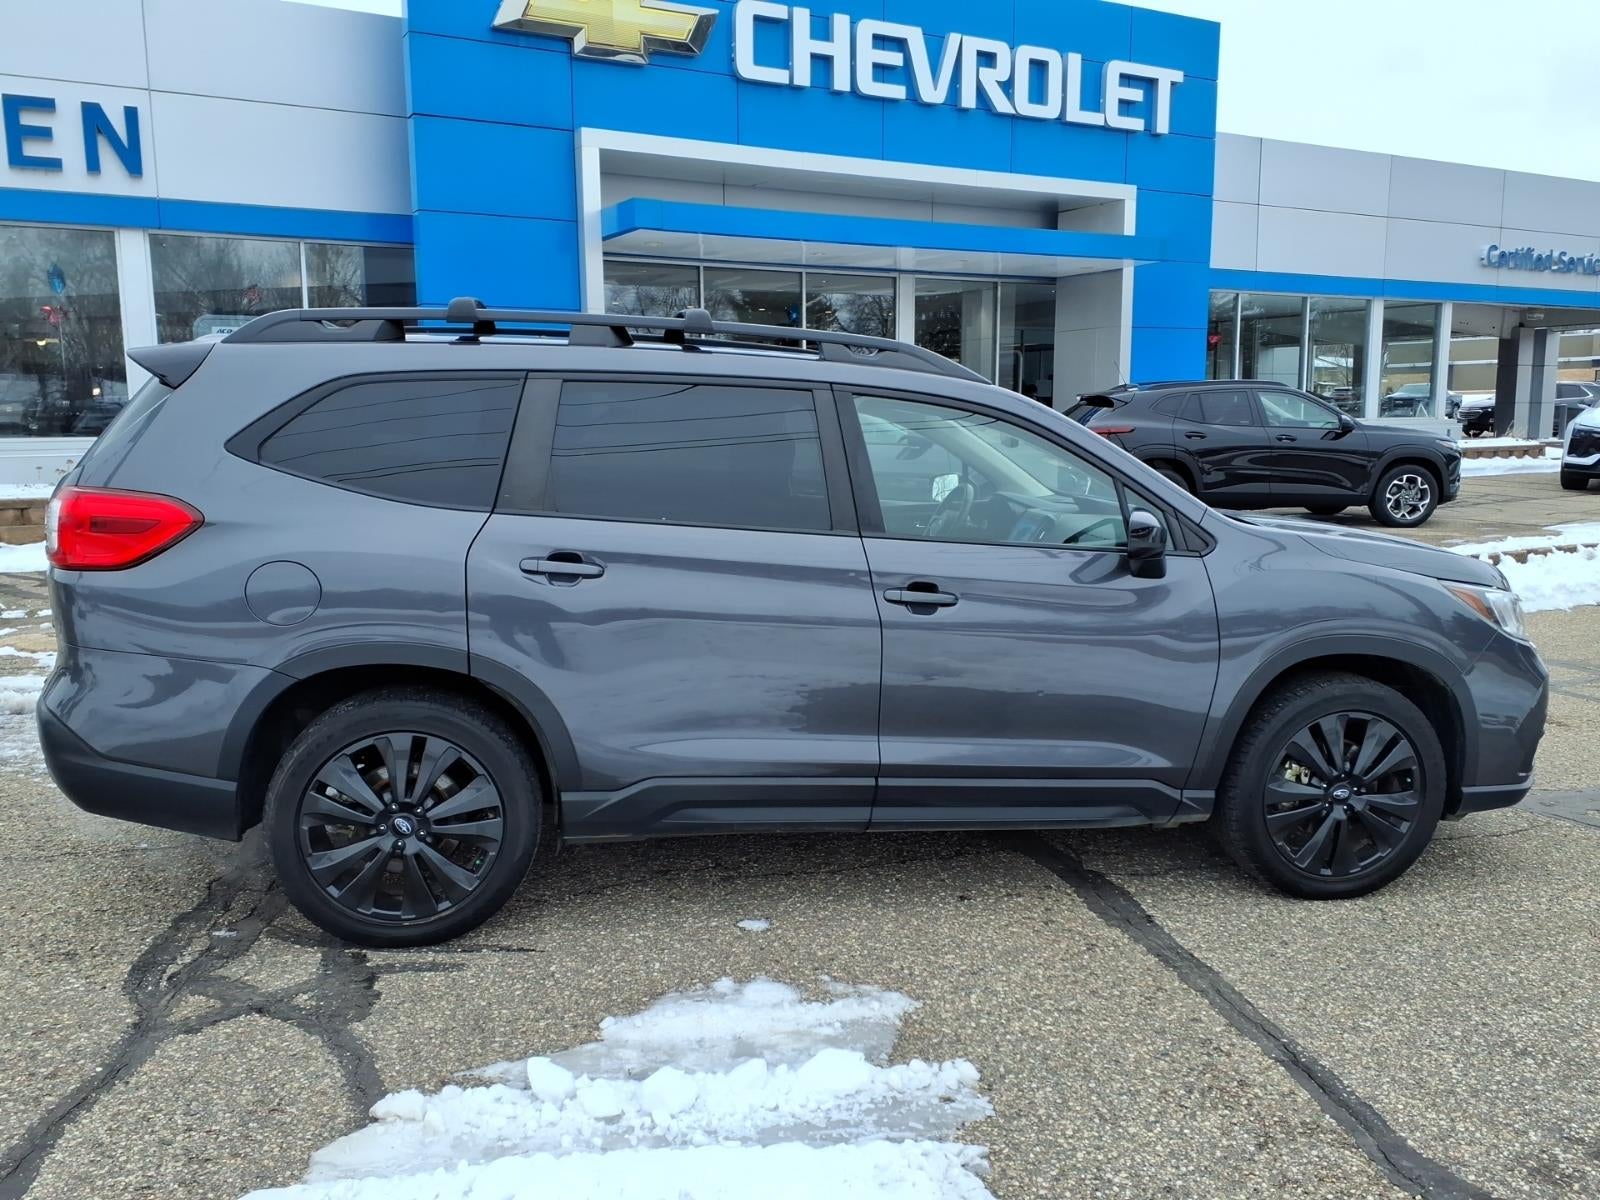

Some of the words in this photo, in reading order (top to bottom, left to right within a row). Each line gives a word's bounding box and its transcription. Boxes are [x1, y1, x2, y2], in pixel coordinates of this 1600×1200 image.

[732, 0, 1184, 134] CHEVROLET
[2, 93, 143, 177] EN
[1486, 245, 1554, 272] Certified
